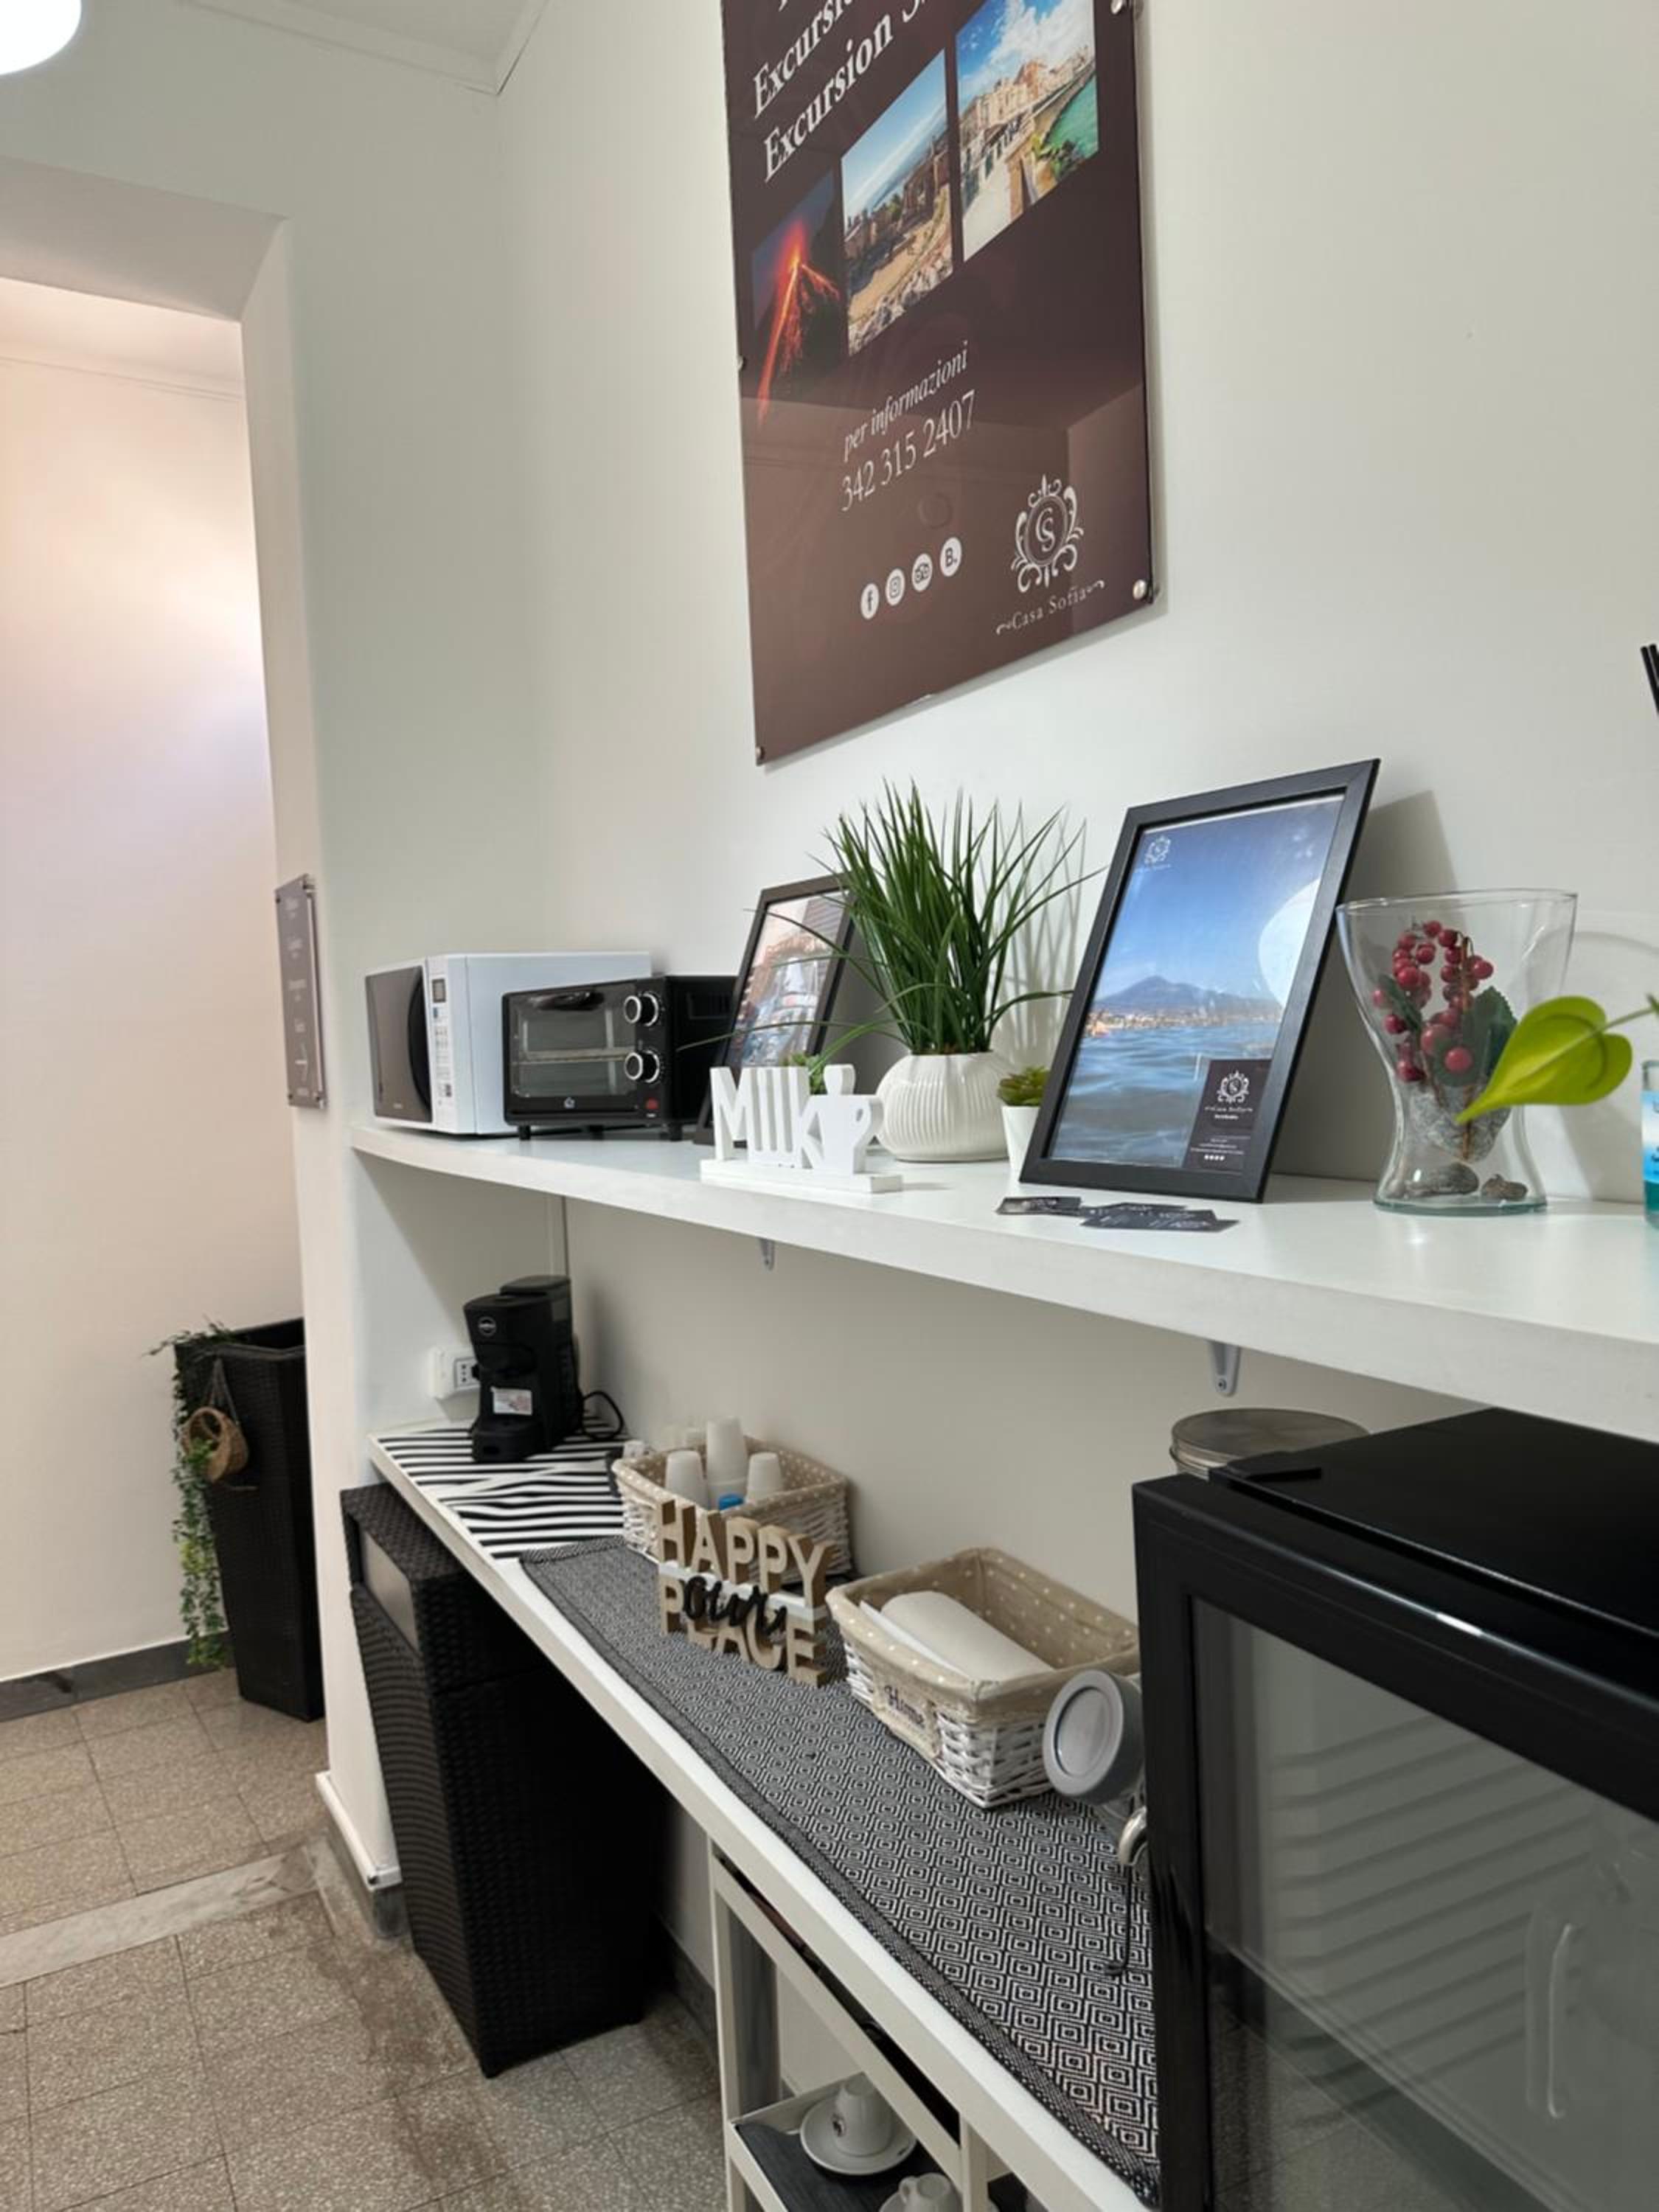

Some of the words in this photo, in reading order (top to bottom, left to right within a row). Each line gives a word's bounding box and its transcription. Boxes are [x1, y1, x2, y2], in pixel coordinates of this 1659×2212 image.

[764, 14, 894, 183] Excursion
[841, 460, 876, 511] 342
[881, 429, 916, 486] 315
[922, 389, 975, 458] 2407
[844, 422, 868, 464] per
[871, 340, 968, 436] informazioni
[1012, 607, 1044, 629] Casa
[1048, 585, 1086, 614] Sofia
[653, 1498, 830, 1607] HAPPY
